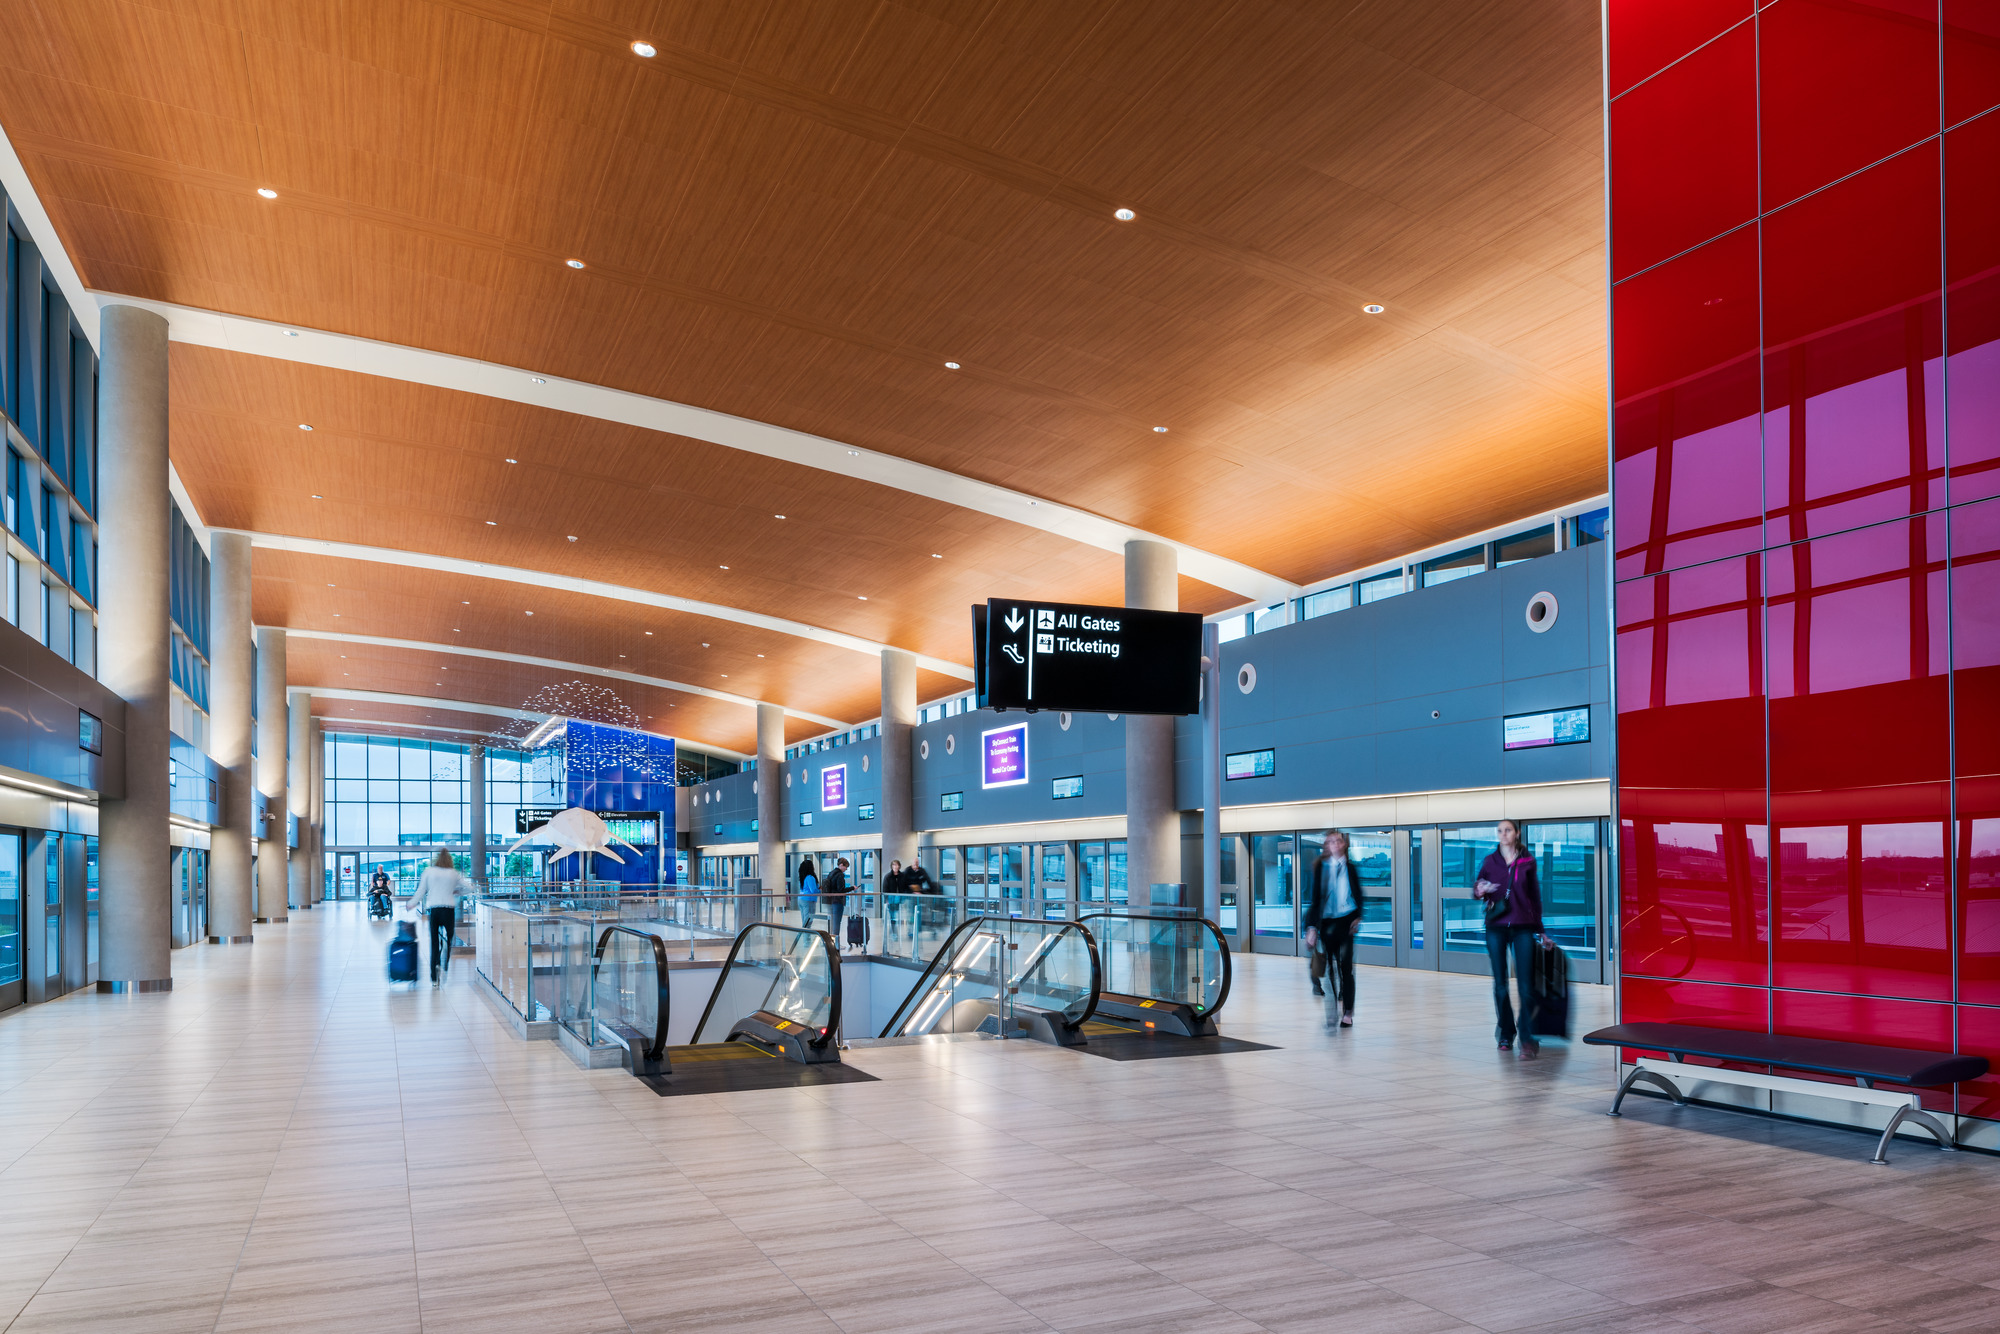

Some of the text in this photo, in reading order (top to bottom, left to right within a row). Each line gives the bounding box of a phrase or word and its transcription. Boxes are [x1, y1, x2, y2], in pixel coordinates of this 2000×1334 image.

[1057, 614, 1120, 632] All Gates
[1057, 637, 1120, 658] Ticketing
